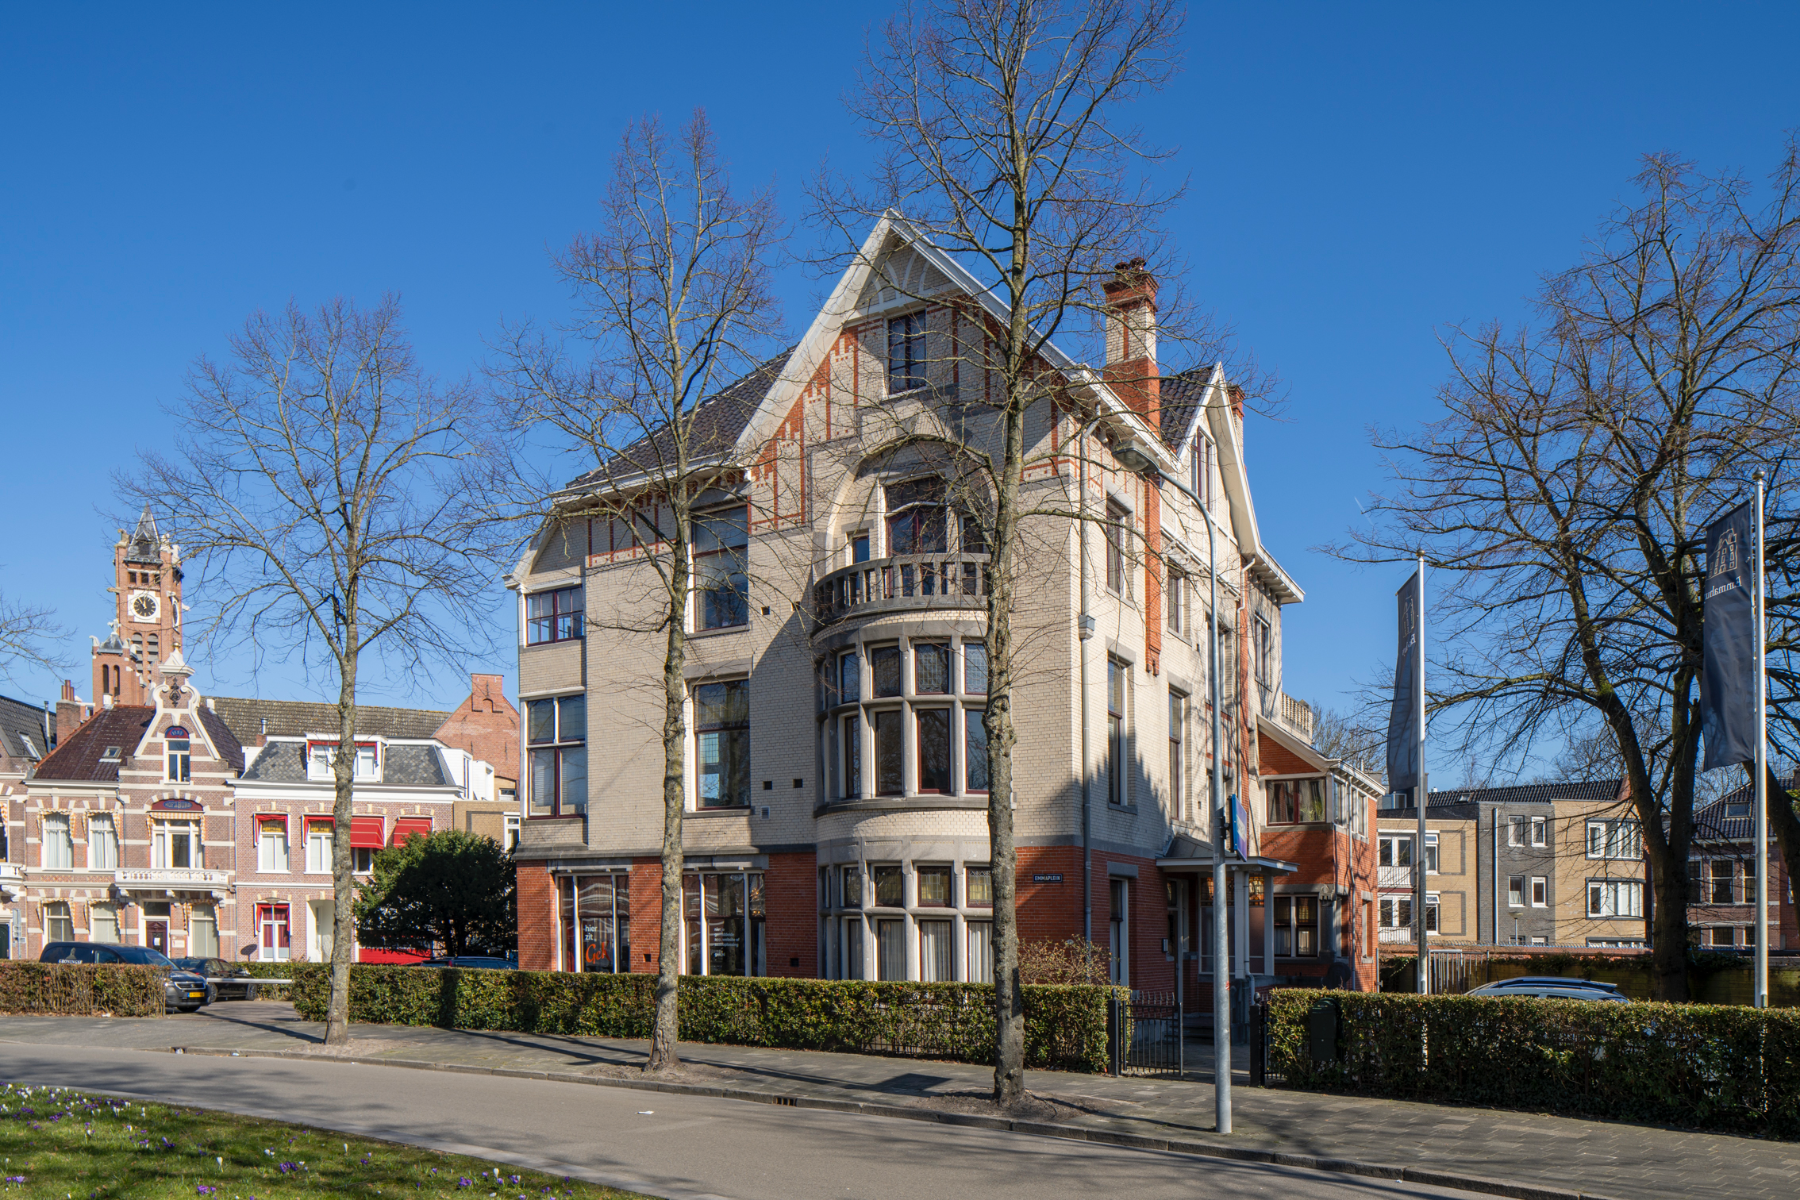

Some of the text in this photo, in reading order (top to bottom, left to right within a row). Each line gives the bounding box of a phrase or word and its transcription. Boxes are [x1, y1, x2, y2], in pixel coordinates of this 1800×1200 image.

[584, 924, 597, 932] hier
[584, 932, 594, 940] zit
[585, 941, 611, 965] Gek
